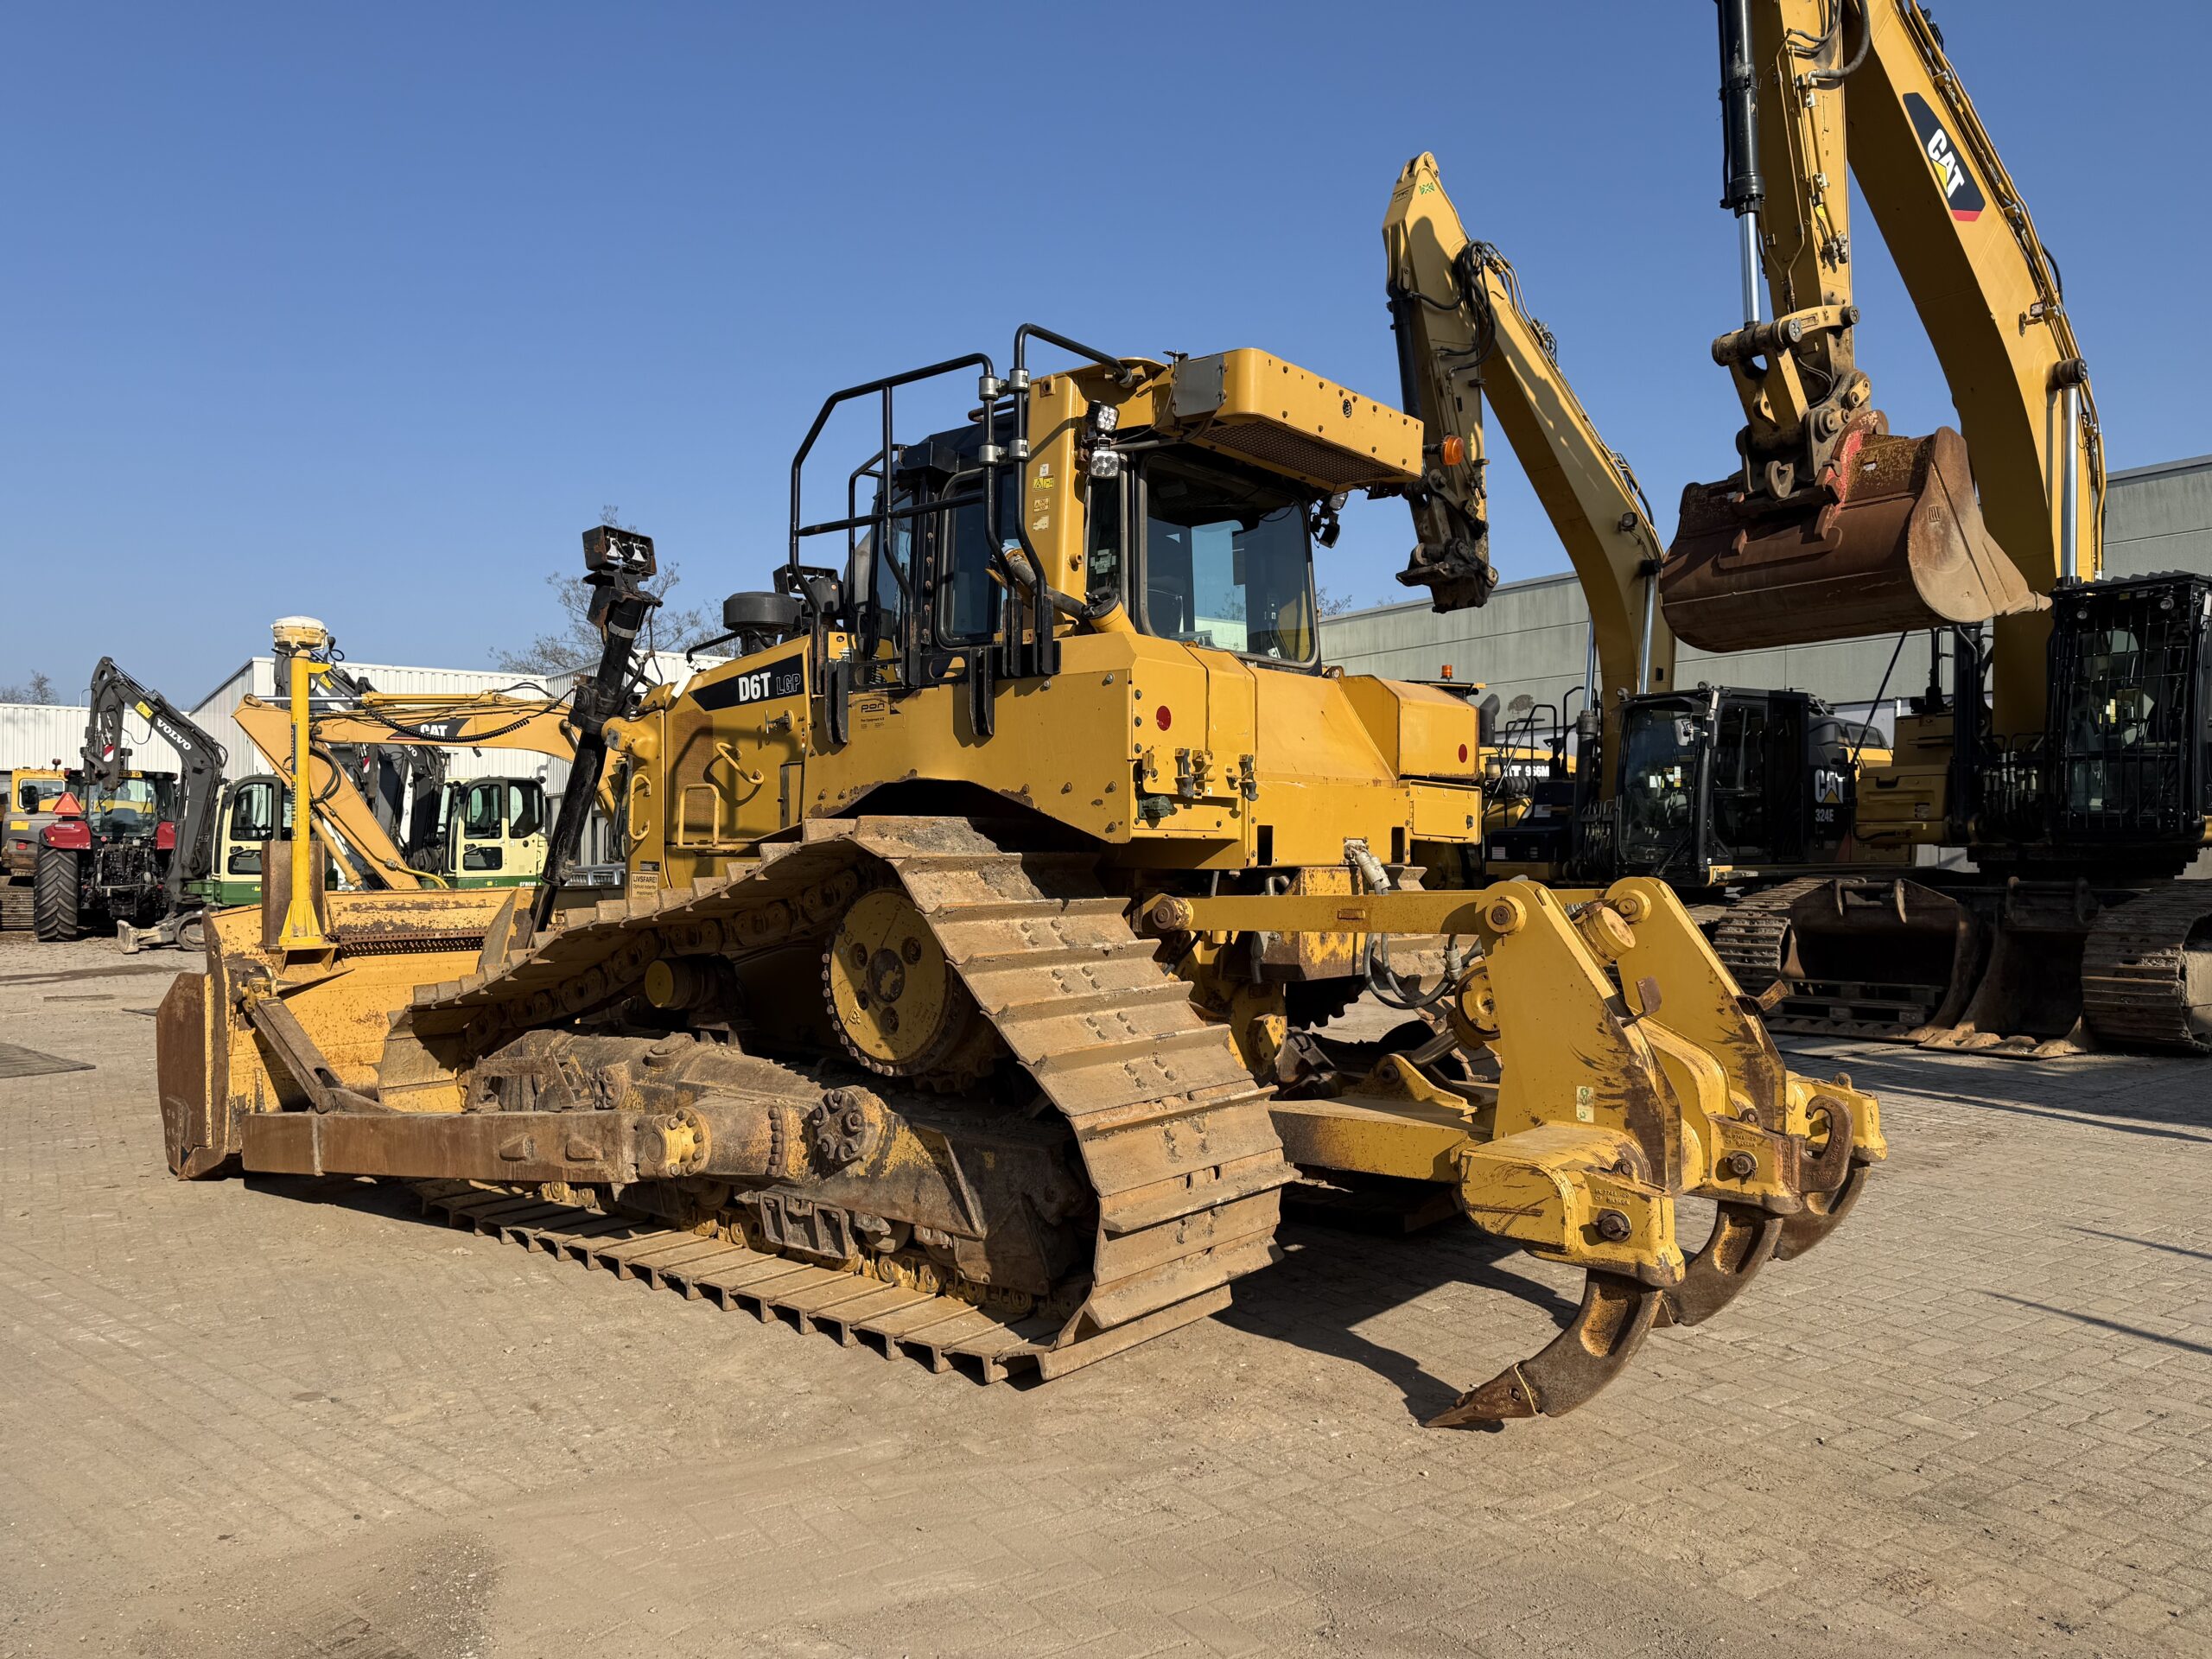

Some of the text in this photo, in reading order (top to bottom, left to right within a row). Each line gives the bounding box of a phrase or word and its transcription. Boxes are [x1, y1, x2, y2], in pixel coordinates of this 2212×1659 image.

[1928, 129, 1965, 199] CAT
[738, 671, 801, 702] D6T LGP
[156, 717, 191, 751] VOLVO
[420, 724, 448, 737] CAT
[1815, 769, 1846, 804] CAT
[1815, 808, 1834, 823] 324E
